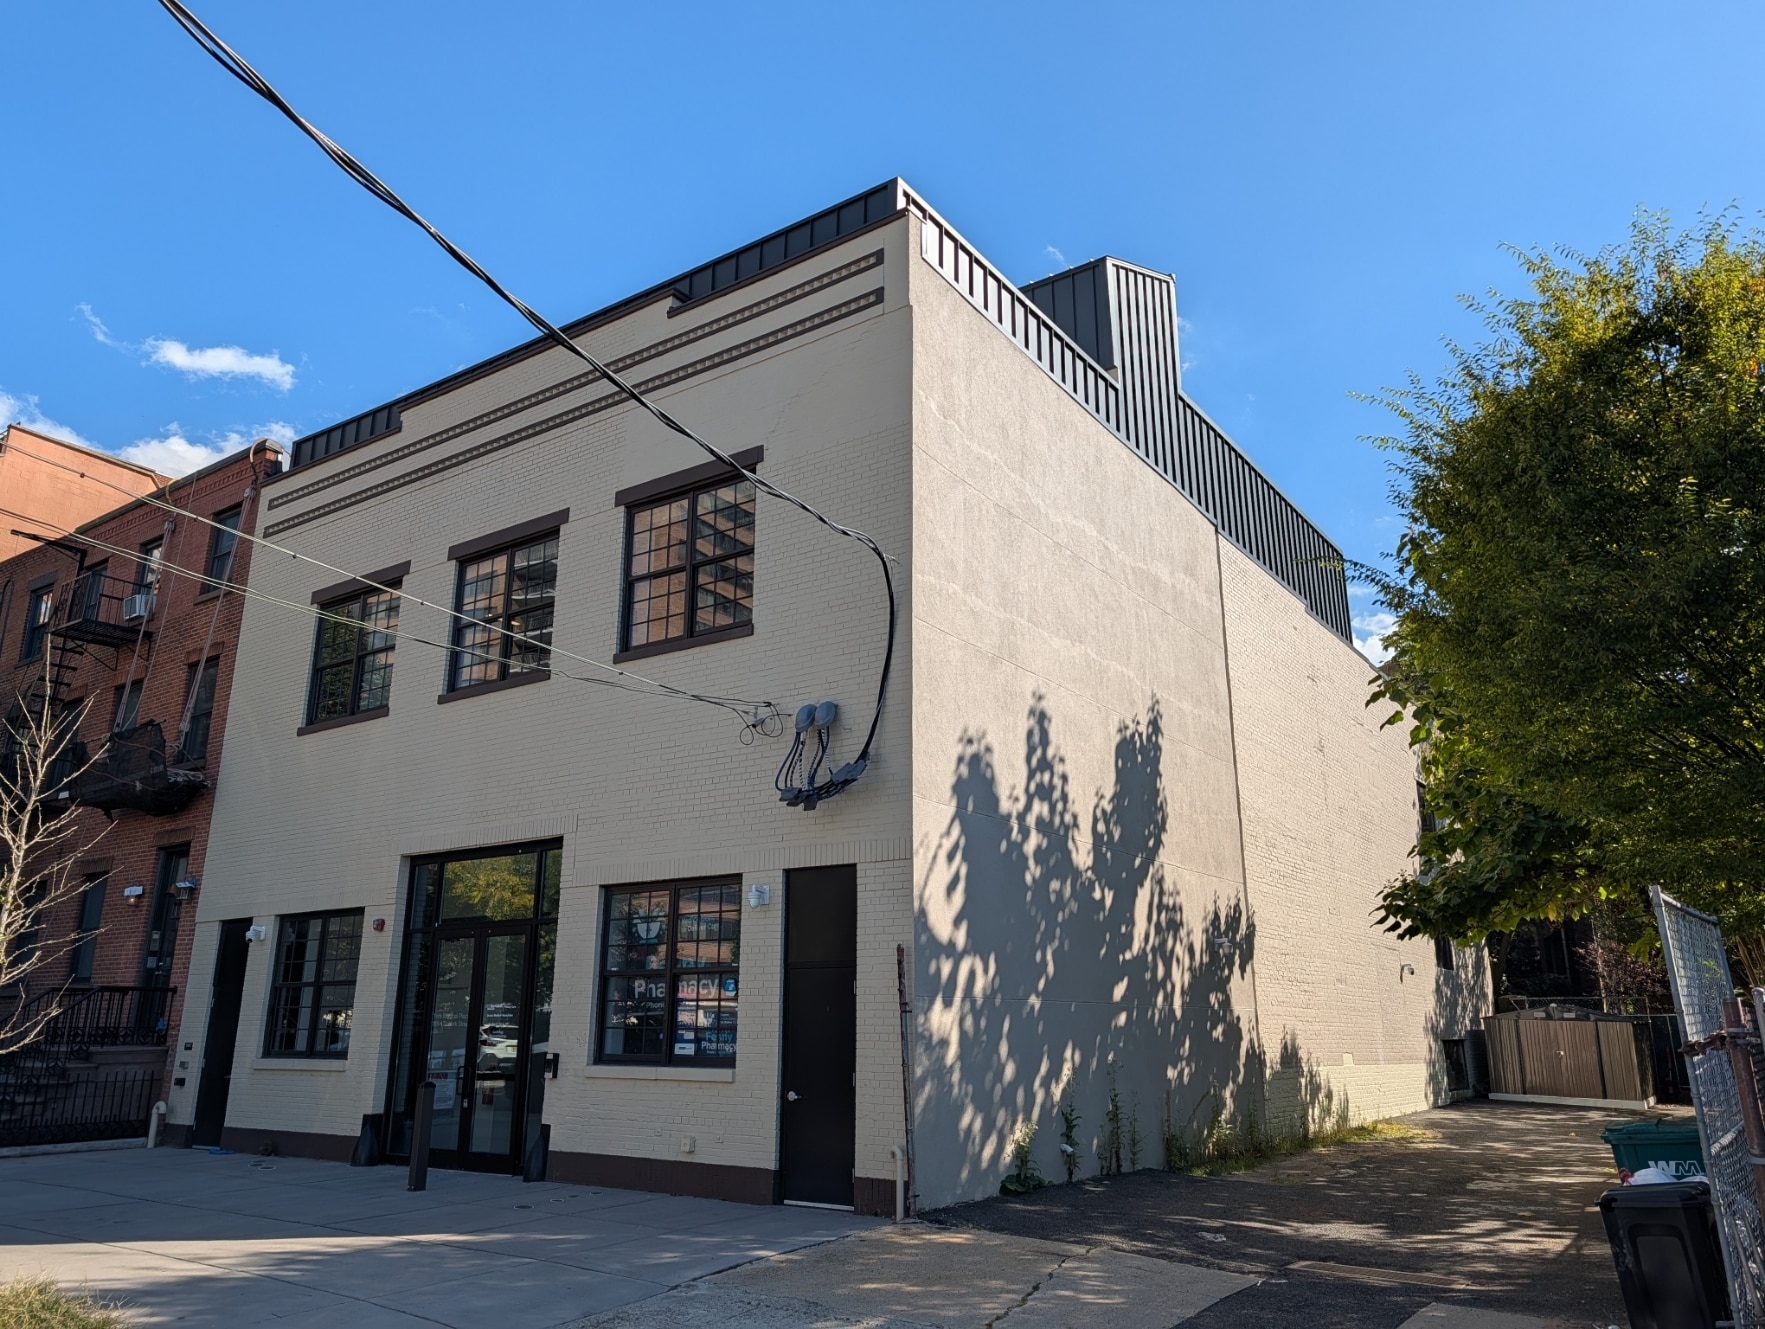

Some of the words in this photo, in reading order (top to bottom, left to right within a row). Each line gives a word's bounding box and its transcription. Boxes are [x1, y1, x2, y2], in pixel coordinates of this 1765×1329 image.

[635, 979, 719, 999] Phamacy
[701, 1041, 737, 1051] Phamacy
[1647, 1160, 1702, 1176] WM
